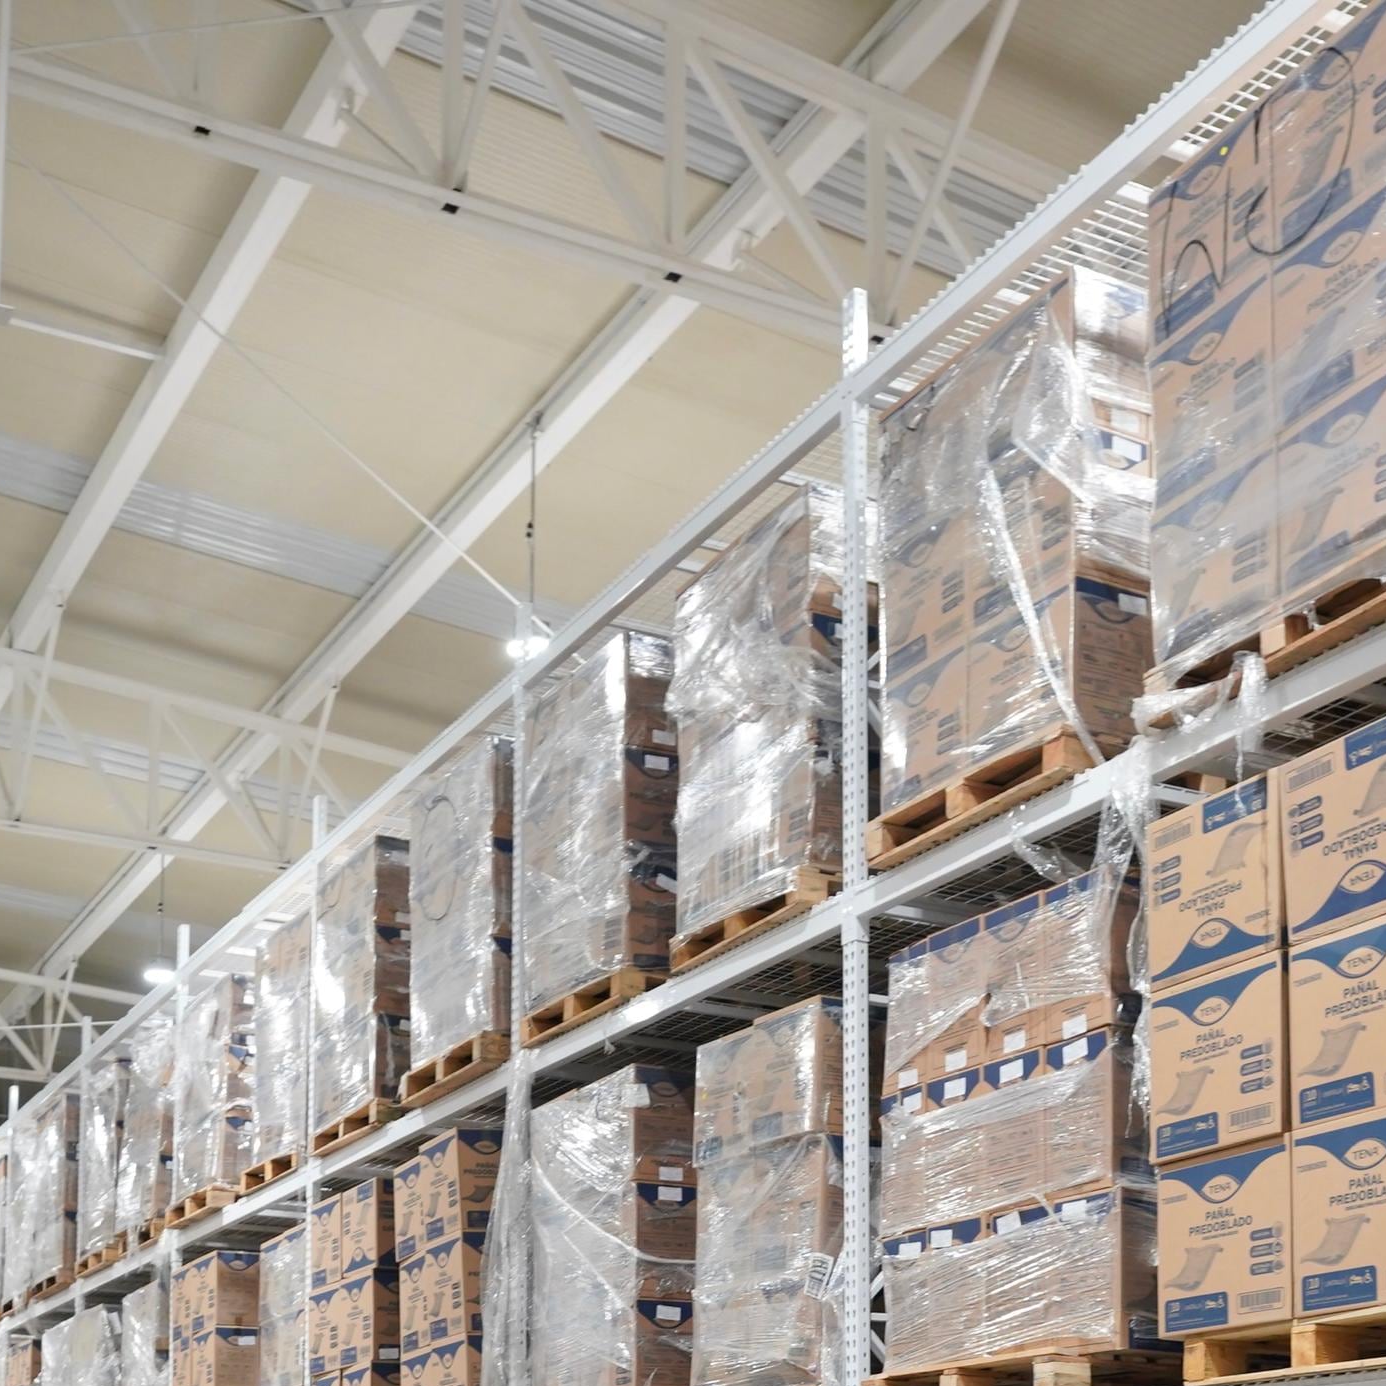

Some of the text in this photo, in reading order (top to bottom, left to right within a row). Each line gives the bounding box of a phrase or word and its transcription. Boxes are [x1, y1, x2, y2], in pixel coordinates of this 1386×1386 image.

[1349, 869, 1374, 886] TENA
[1178, 880, 1241, 911] PREDOBLADO
[1349, 953, 1374, 968] TENA
[1200, 1003, 1221, 1017] TENA
[1179, 1034, 1243, 1061] PREDOBLADO
[1353, 1146, 1378, 1159] TENA
[1209, 1182, 1230, 1194] TENA
[1190, 1215, 1252, 1236] PREDOBLADO
